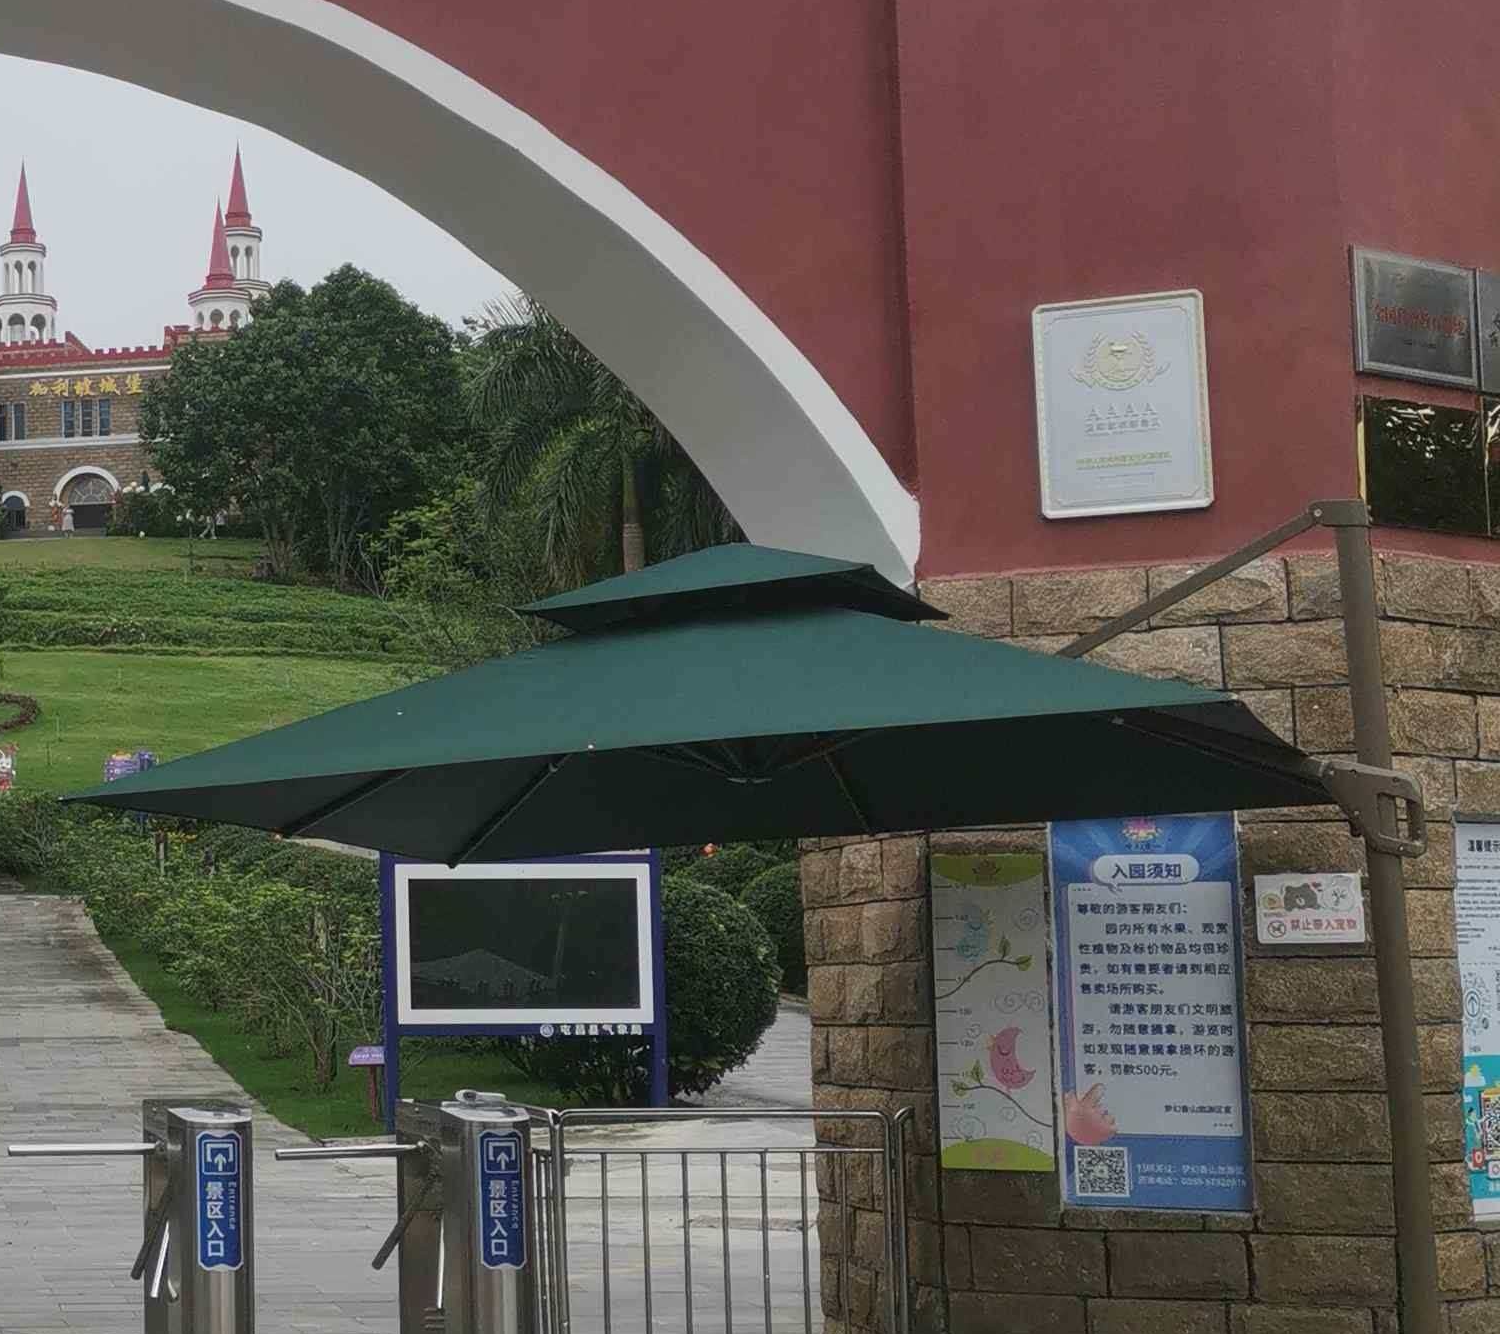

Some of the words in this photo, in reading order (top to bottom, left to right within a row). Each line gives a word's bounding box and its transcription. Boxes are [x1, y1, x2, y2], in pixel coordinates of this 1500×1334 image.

[1112, 863, 1182, 879] 入园须知
[206, 1181, 224, 1257] 景区入口
[228, 1181, 237, 1230] Entrance
[489, 1180, 508, 1256] 景区入口
[511, 1180, 520, 1229] Entrance
